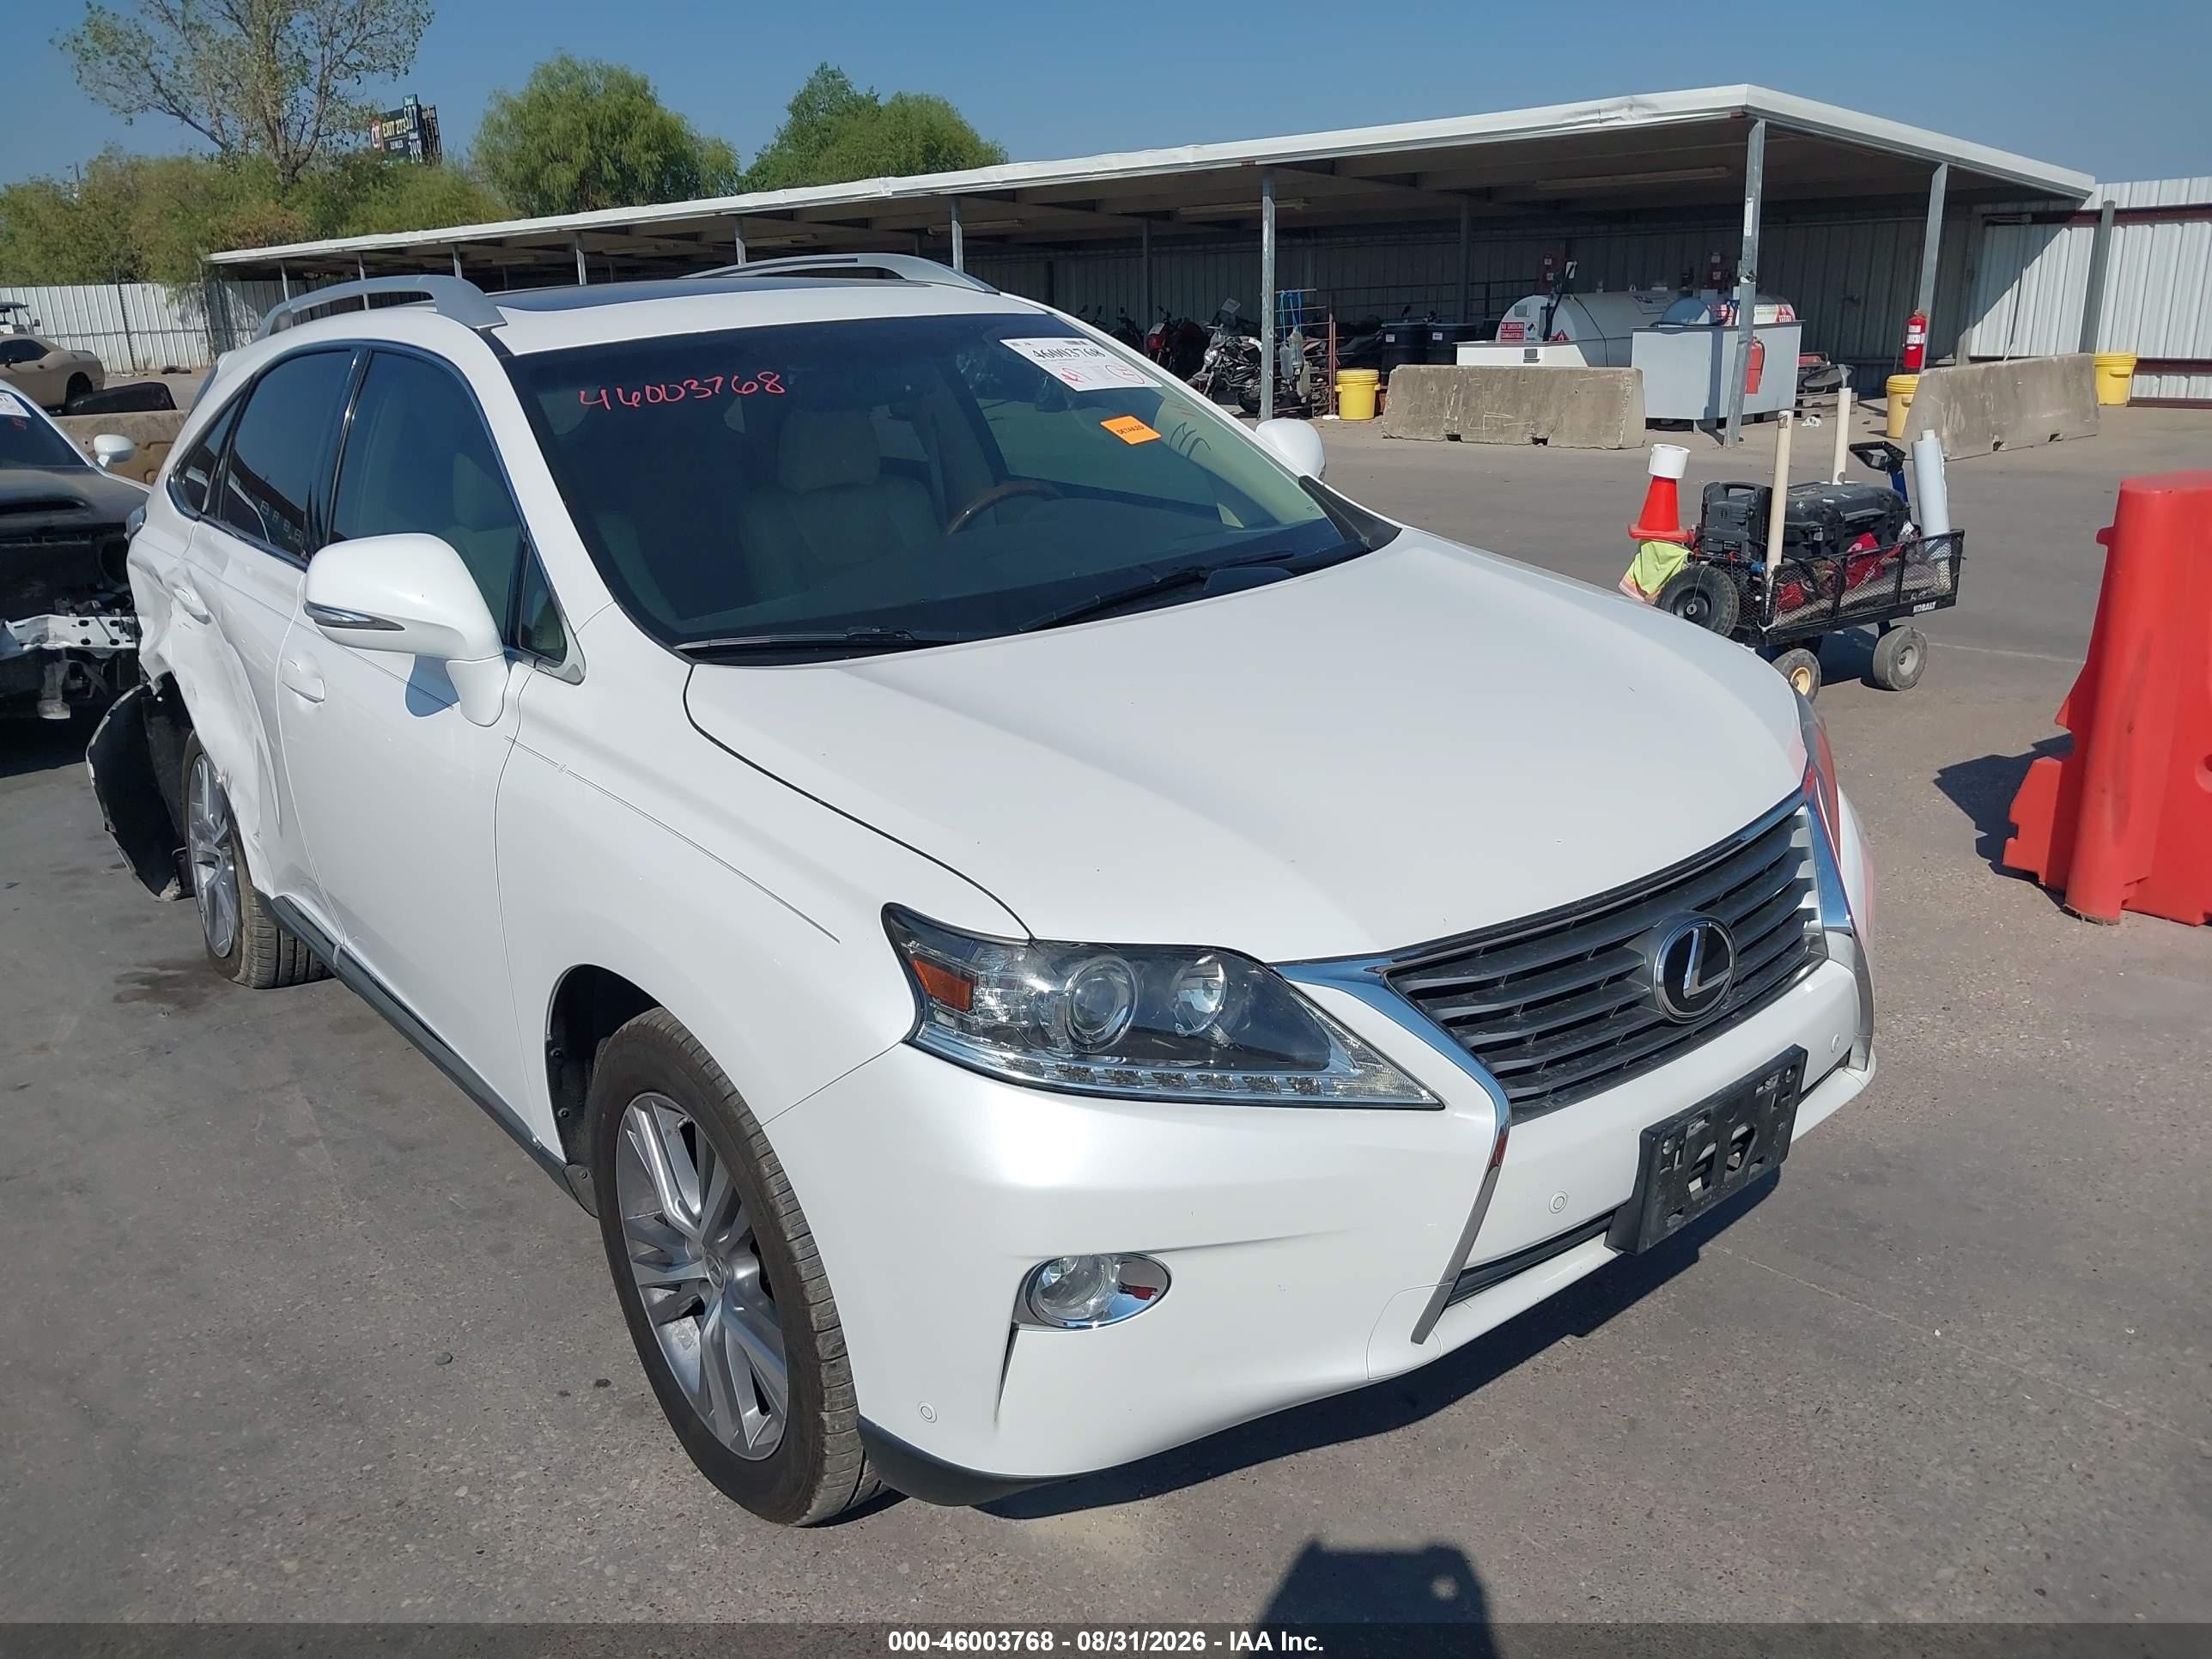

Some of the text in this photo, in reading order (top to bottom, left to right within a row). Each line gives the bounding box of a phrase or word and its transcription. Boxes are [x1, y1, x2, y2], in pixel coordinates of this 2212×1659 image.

[382, 121, 395, 137] EXIT
[396, 118, 406, 133] 273
[1030, 346, 1106, 359] 46003768
[579, 370, 787, 411] 46003768
[1912, 600, 1937, 614] KOBALT
